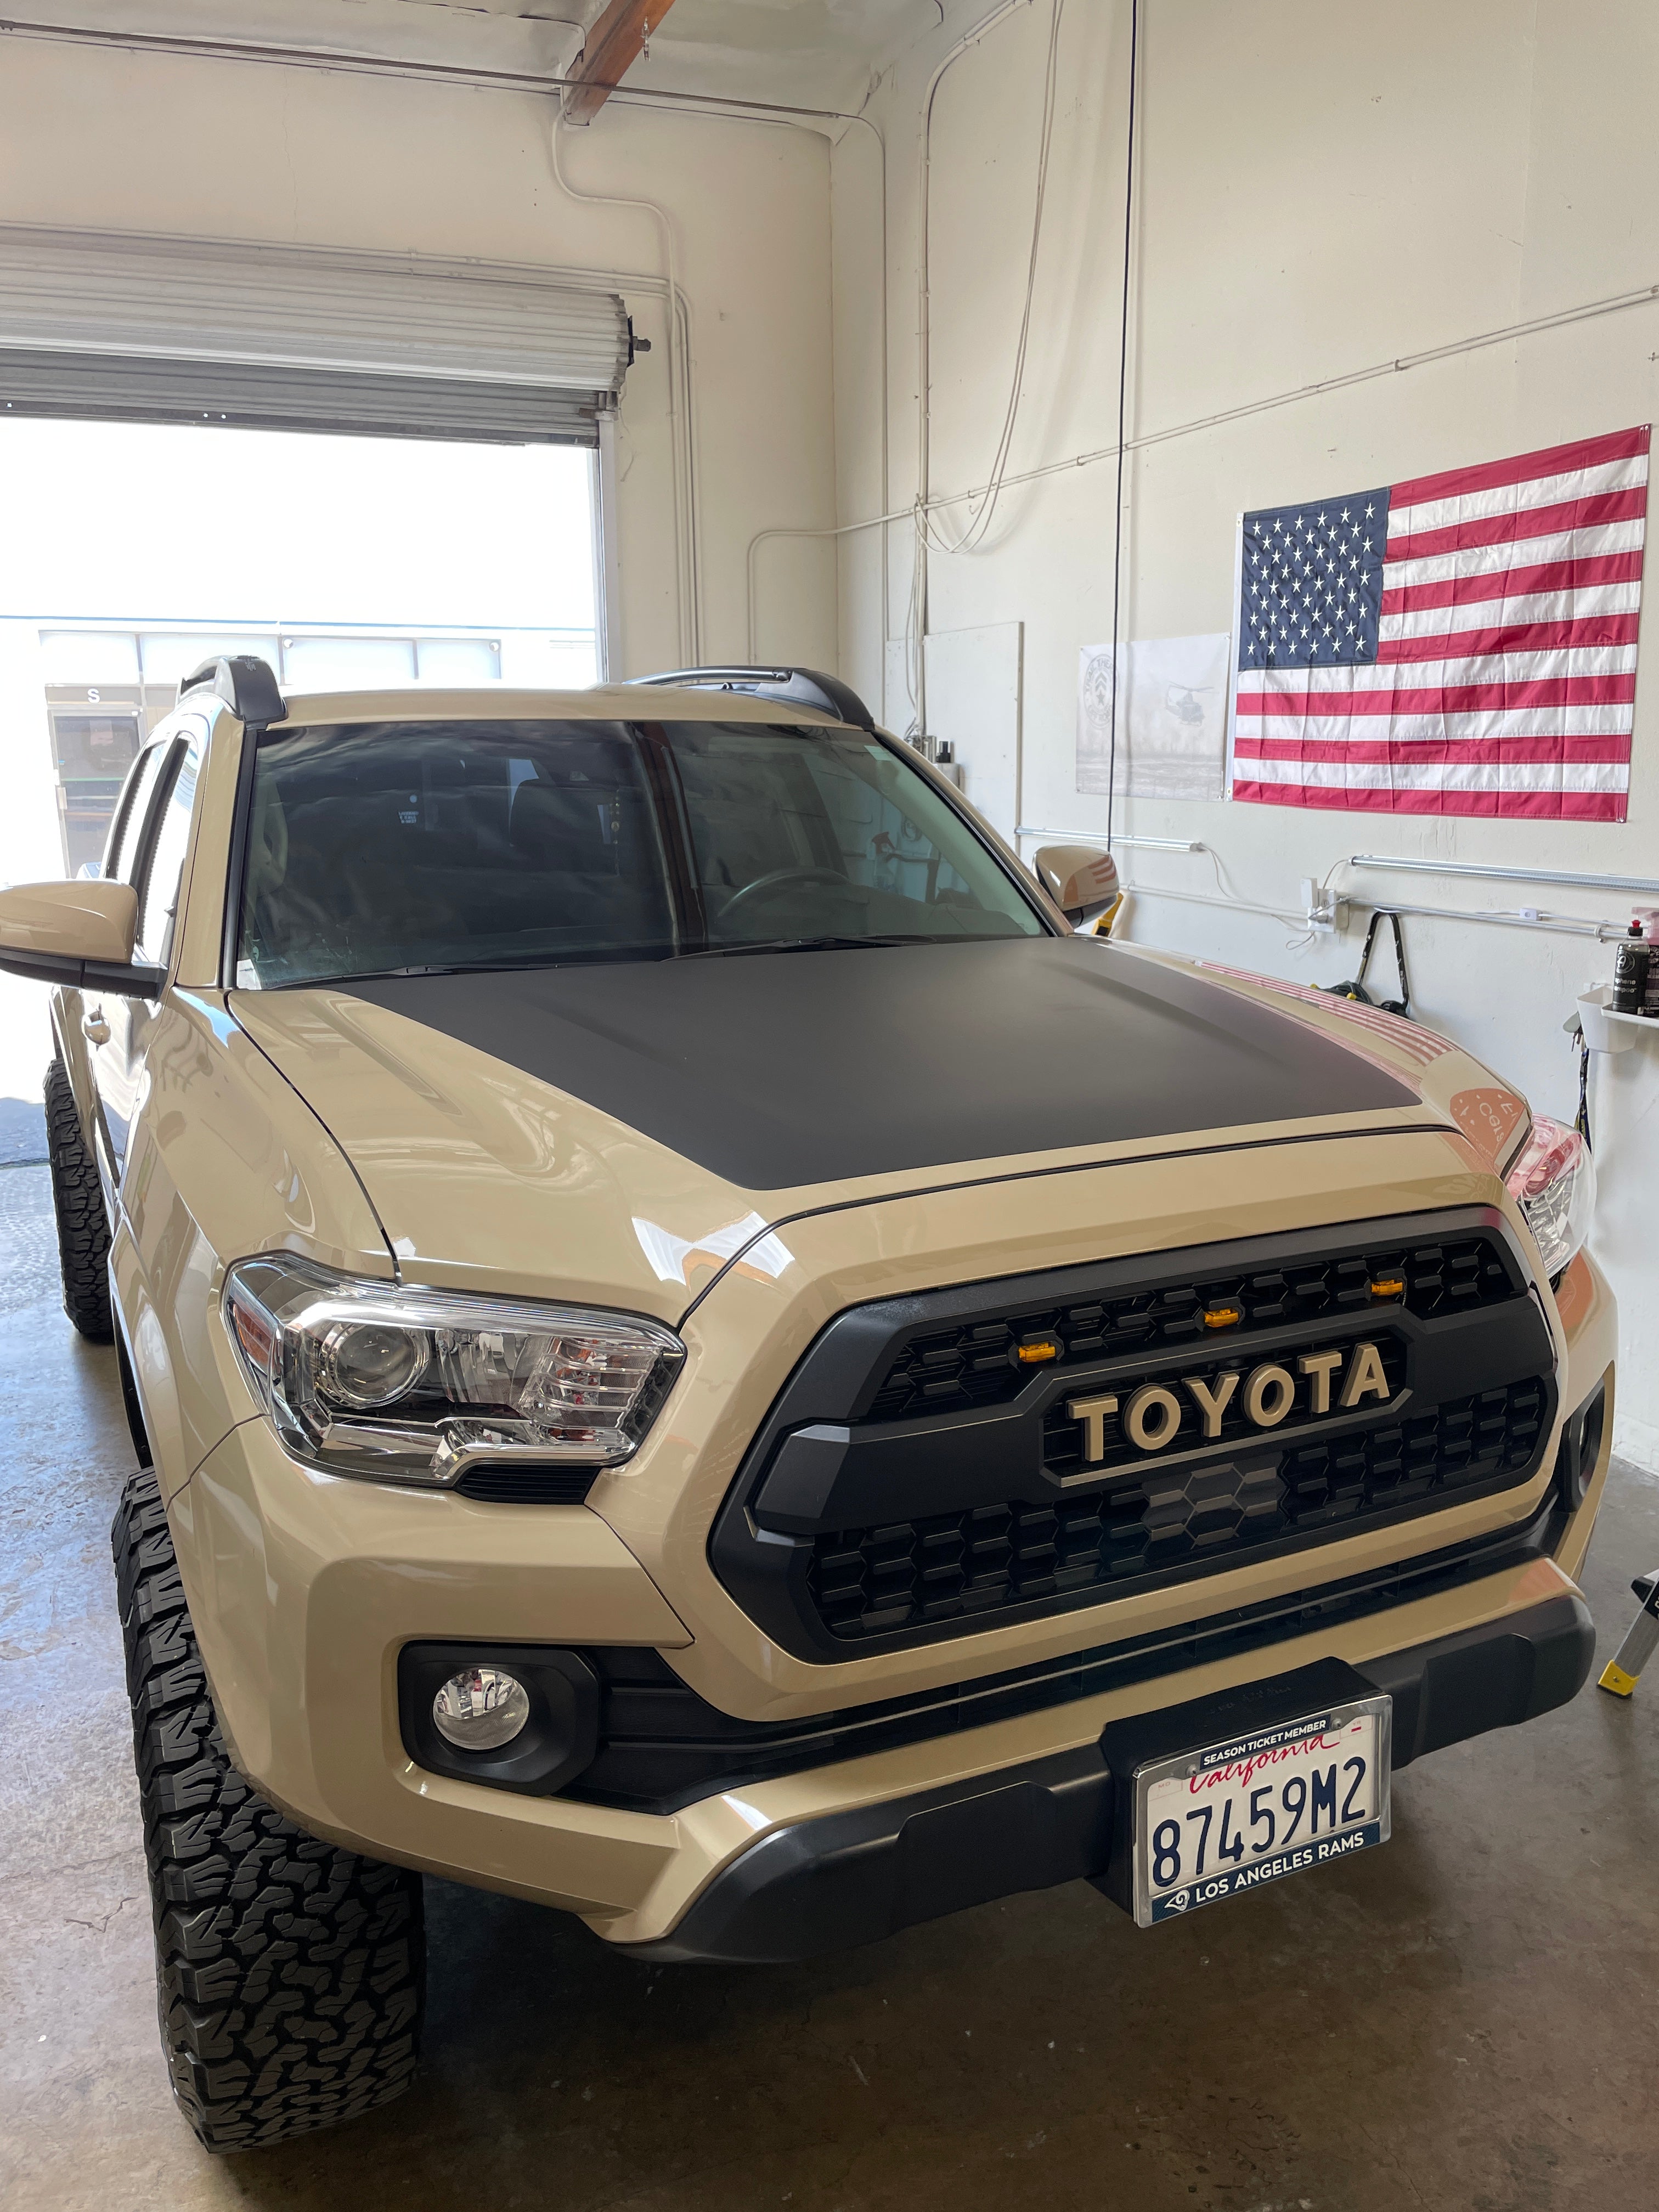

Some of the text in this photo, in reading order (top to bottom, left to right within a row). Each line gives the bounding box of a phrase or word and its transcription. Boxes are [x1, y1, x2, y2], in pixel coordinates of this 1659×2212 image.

[88, 688, 100, 703] S
[1068, 1343, 1390, 1462] TOYOTA
[1189, 1734, 1340, 1793] California
[1203, 1719, 1327, 1765] SEASON TICKET MEMBER
[1153, 1756, 1366, 1887] 87459M2
[1195, 1831, 1364, 1903] LOS ANGELES RAMS
